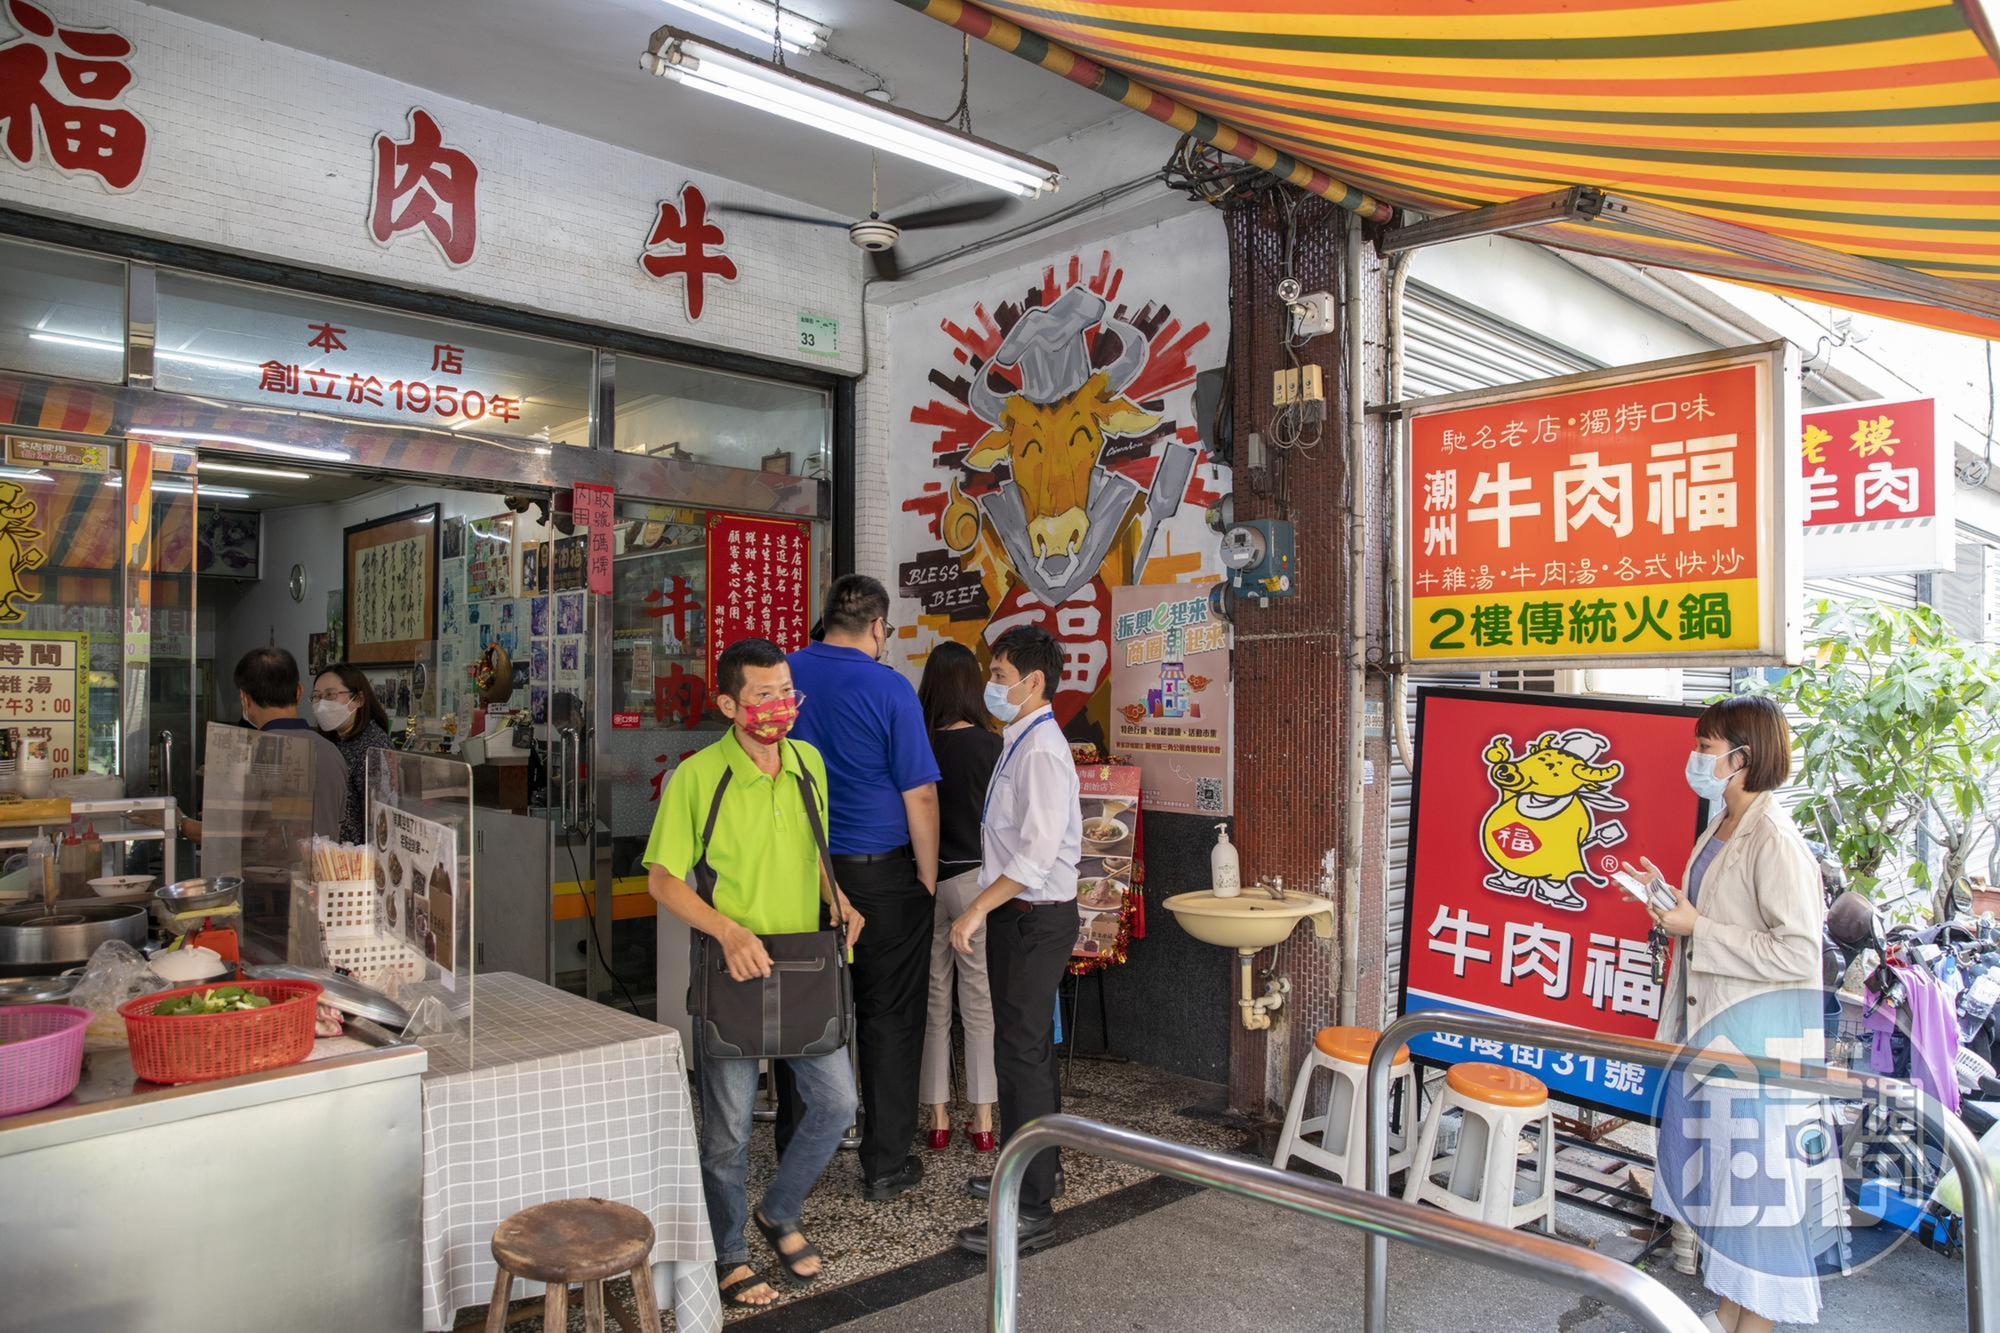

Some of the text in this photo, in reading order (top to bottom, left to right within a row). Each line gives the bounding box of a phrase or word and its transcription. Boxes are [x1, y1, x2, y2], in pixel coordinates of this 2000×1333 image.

[801, 332, 815, 346] 33
[259, 360, 520, 423] 創立於1950年
[1424, 469, 1457, 557] 潮州
[1467, 434, 1738, 548] 牛肉福
[761, 533, 773, 640] 土生土長的台灣
[904, 563, 960, 586] BLESS
[930, 584, 982, 608] BEEF
[1430, 592, 1731, 650] 2樓傳統火鍋
[1497, 827, 1535, 853] 福
[1428, 904, 1662, 1020] 牛肉福
